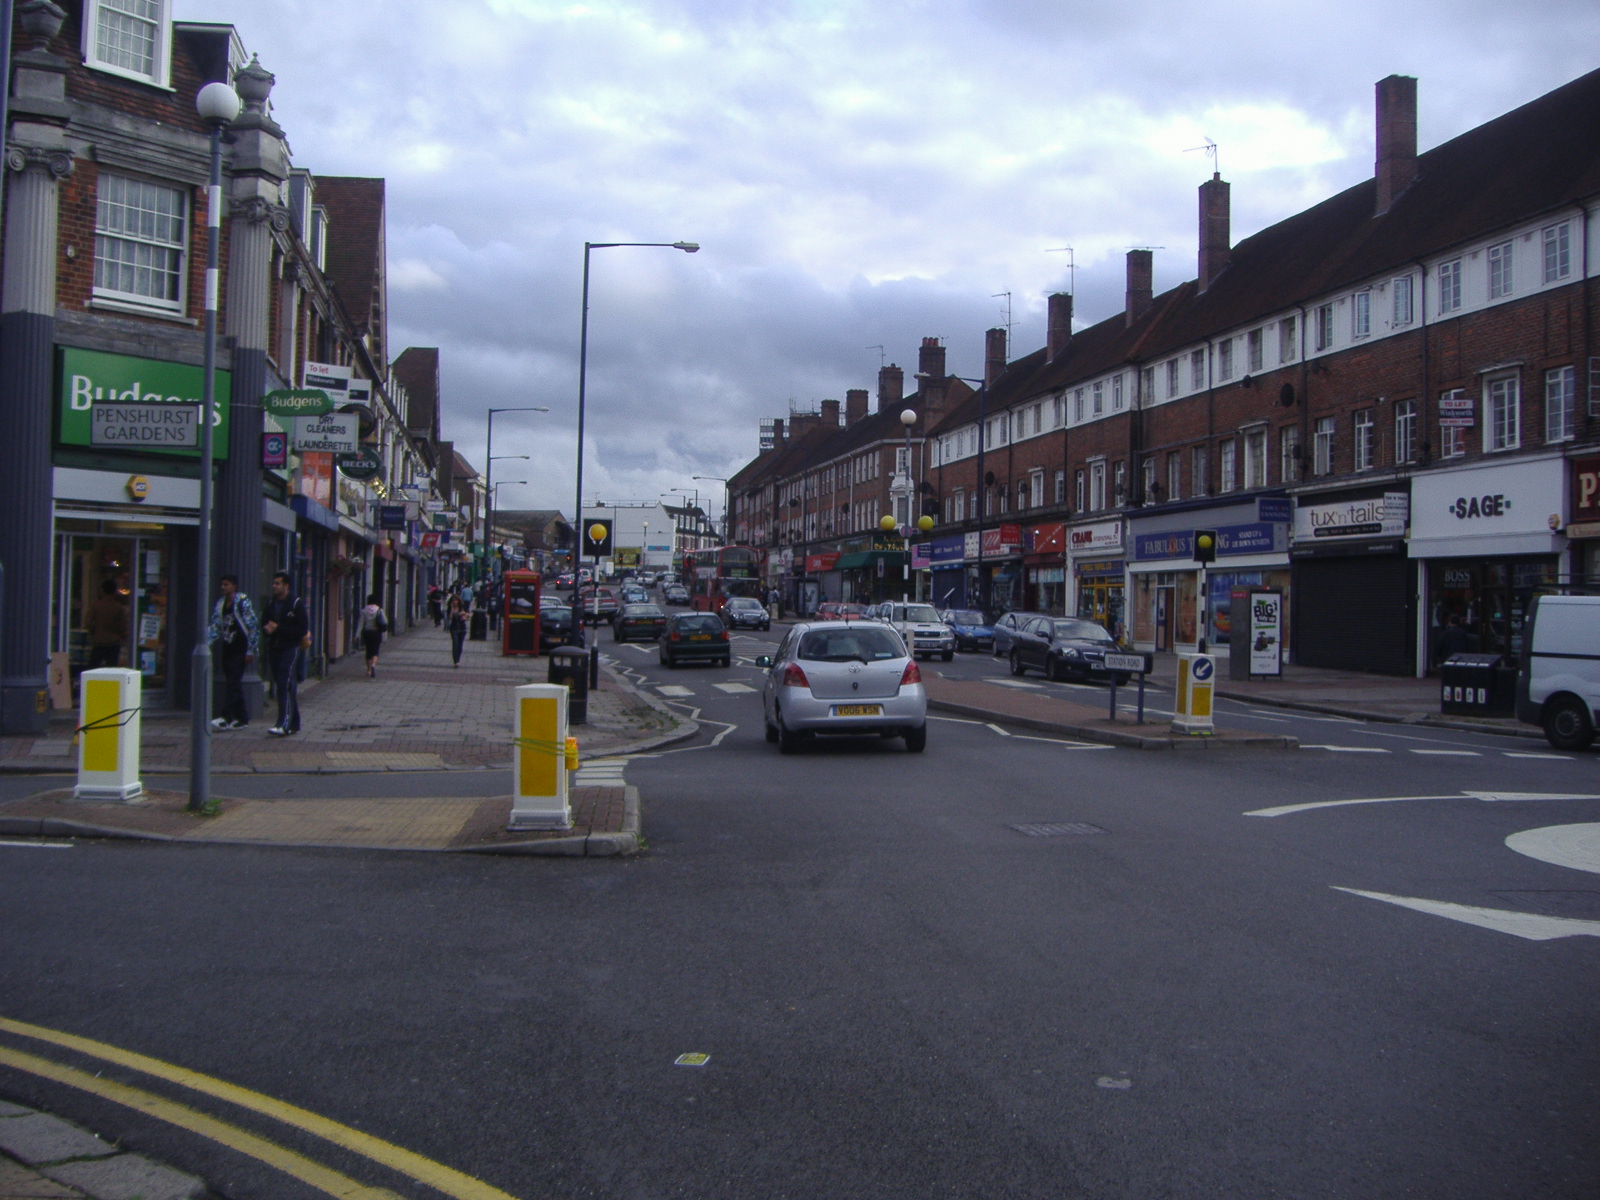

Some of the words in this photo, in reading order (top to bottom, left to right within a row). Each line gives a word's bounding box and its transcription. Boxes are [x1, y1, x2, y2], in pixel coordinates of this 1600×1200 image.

[319, 366, 328, 374] let
[271, 395, 322, 410] Budgens
[95, 408, 193, 424] PENSHURST
[1439, 409, 1473, 417] Winkworth
[319, 416, 334, 425] DRY
[104, 425, 186, 441] GARDENS
[306, 424, 346, 435] CLEANERS
[298, 440, 352, 451] LAUNDERETTE
[341, 460, 377, 469] BECK'S
[1455, 494, 1504, 520] SAGE
[1144, 537, 1186, 554] FABULOUS
[1444, 568, 1470, 582] BOSS
[1253, 603, 1274, 617] BIG
[1108, 656, 1126, 666] STATION
[1127, 658, 1141, 668] ROAD
